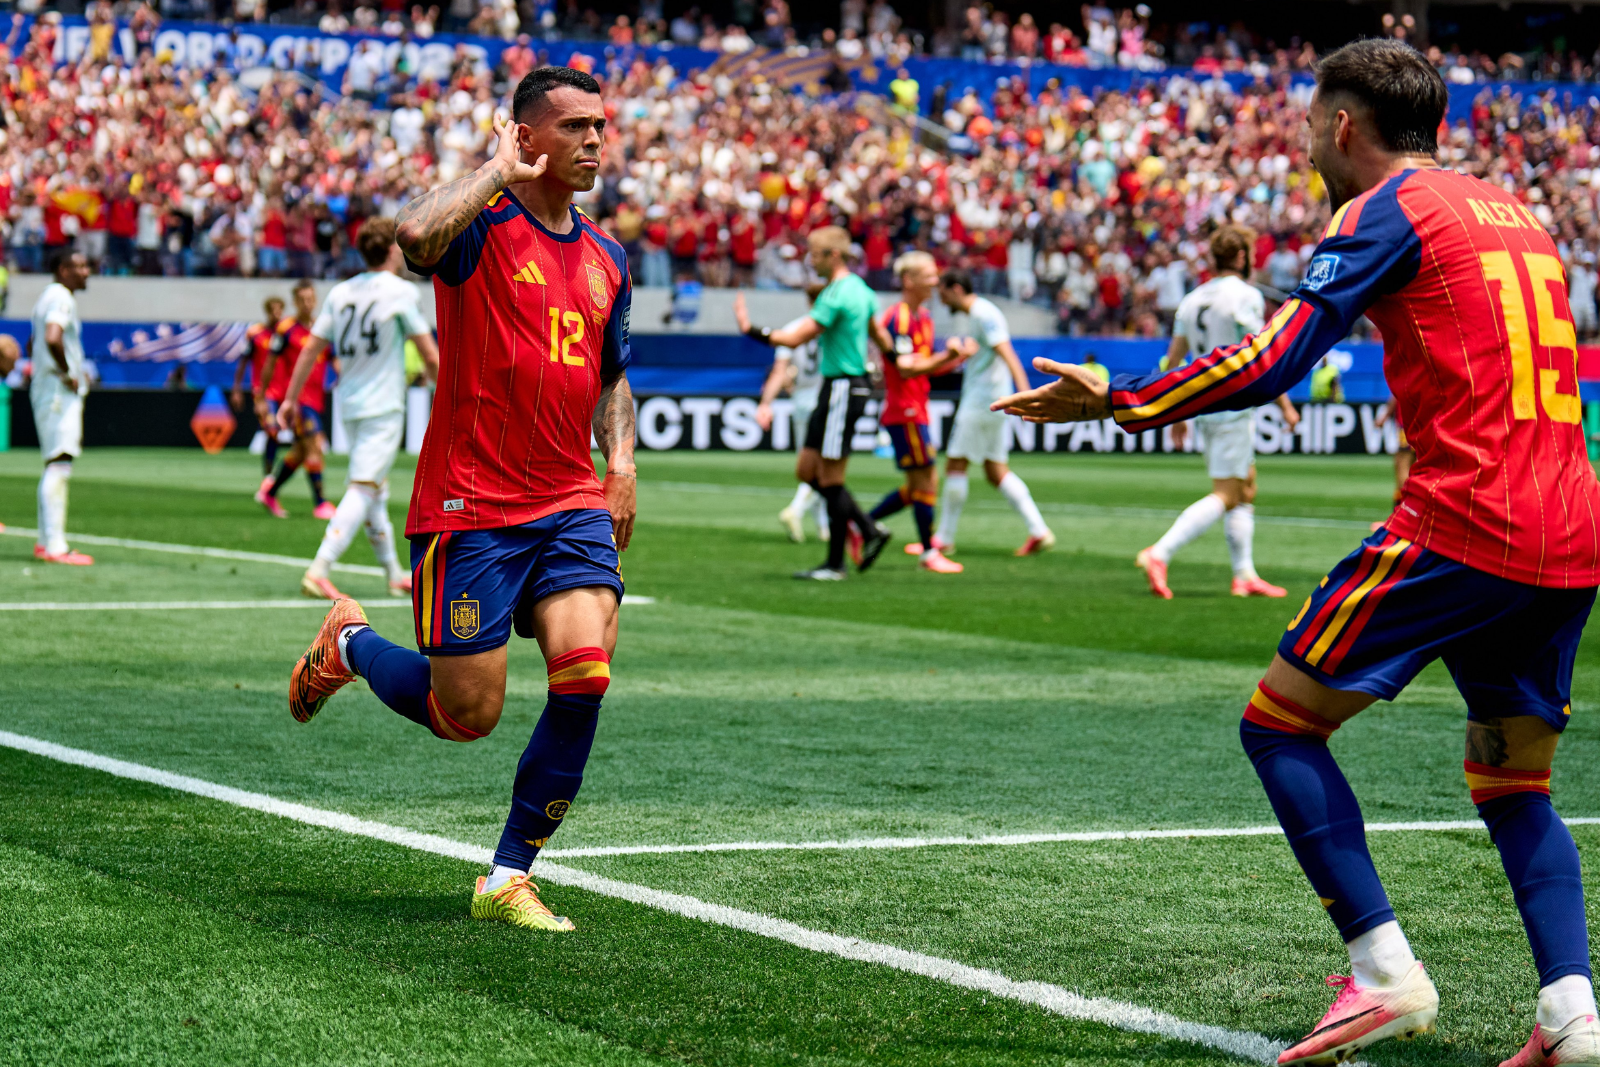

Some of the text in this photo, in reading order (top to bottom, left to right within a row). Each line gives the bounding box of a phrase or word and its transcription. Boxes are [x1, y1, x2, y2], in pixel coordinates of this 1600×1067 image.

[1466, 198, 1528, 229] ALEX
[338, 300, 379, 357] 24
[548, 307, 585, 367] 12
[1479, 250, 1582, 425] 15
